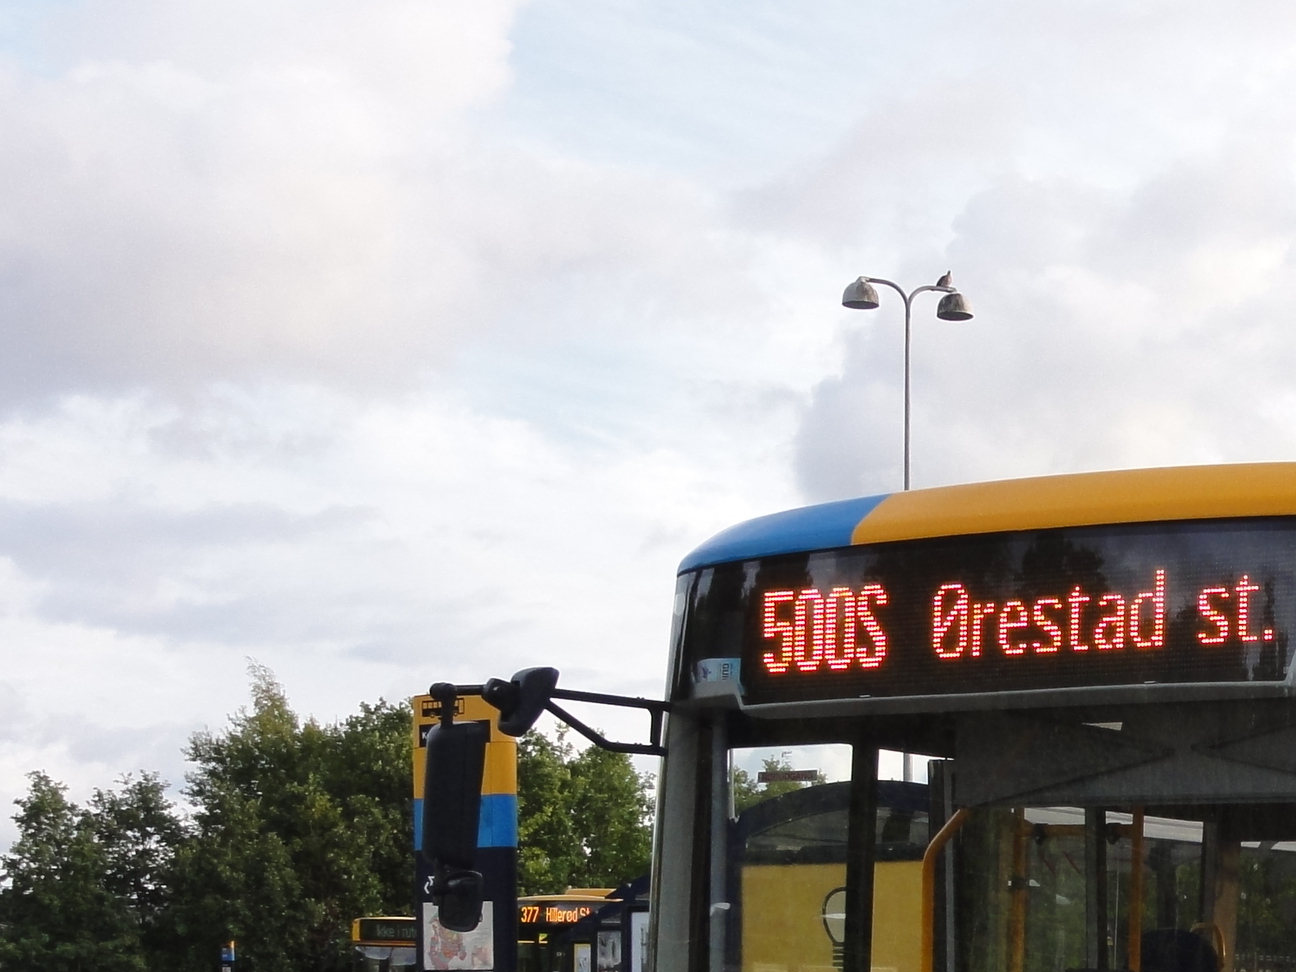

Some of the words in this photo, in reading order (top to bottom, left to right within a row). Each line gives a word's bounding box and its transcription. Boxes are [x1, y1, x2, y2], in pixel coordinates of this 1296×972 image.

[763, 584, 888, 673] 500S
[932, 569, 1165, 659] Ørestad
[1198, 575, 1273, 643] st.
[521, 906, 539, 923] 377
[546, 907, 578, 923] Hillerød
